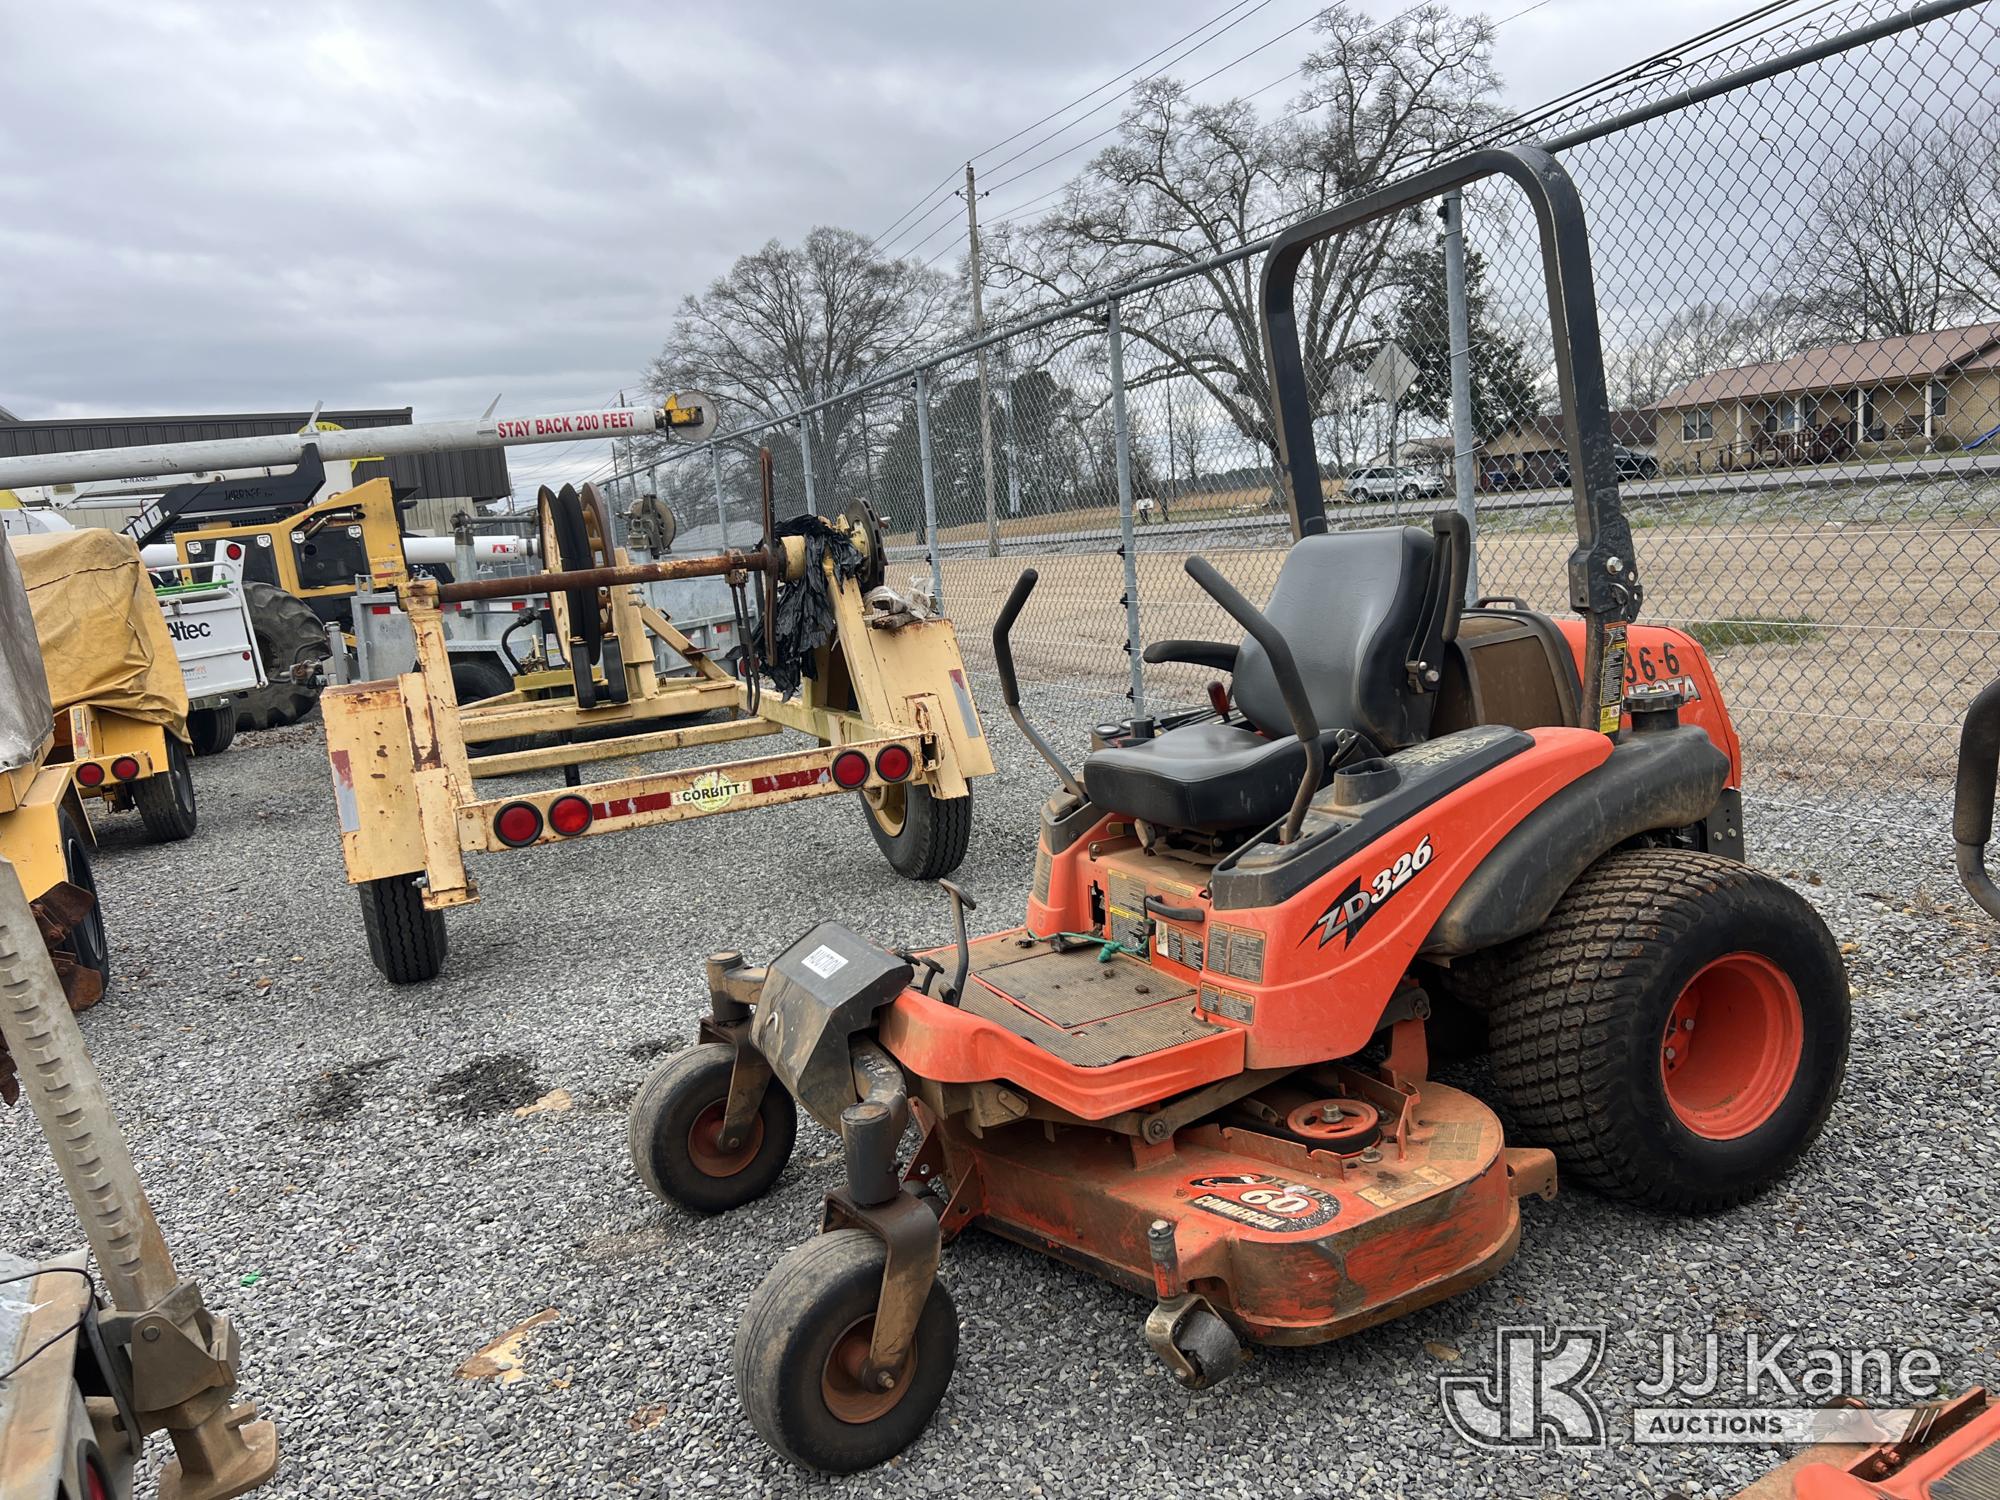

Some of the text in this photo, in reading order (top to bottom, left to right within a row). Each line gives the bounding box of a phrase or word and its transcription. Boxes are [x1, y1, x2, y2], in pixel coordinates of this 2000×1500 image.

[498, 411, 635, 438] STAY BACK 200 FEET
[166, 620, 211, 641] Altec
[682, 783, 740, 802] CORBITT
[1193, 1195, 1287, 1229] COMMERCIAL
[1240, 1189, 1309, 1214] 60
